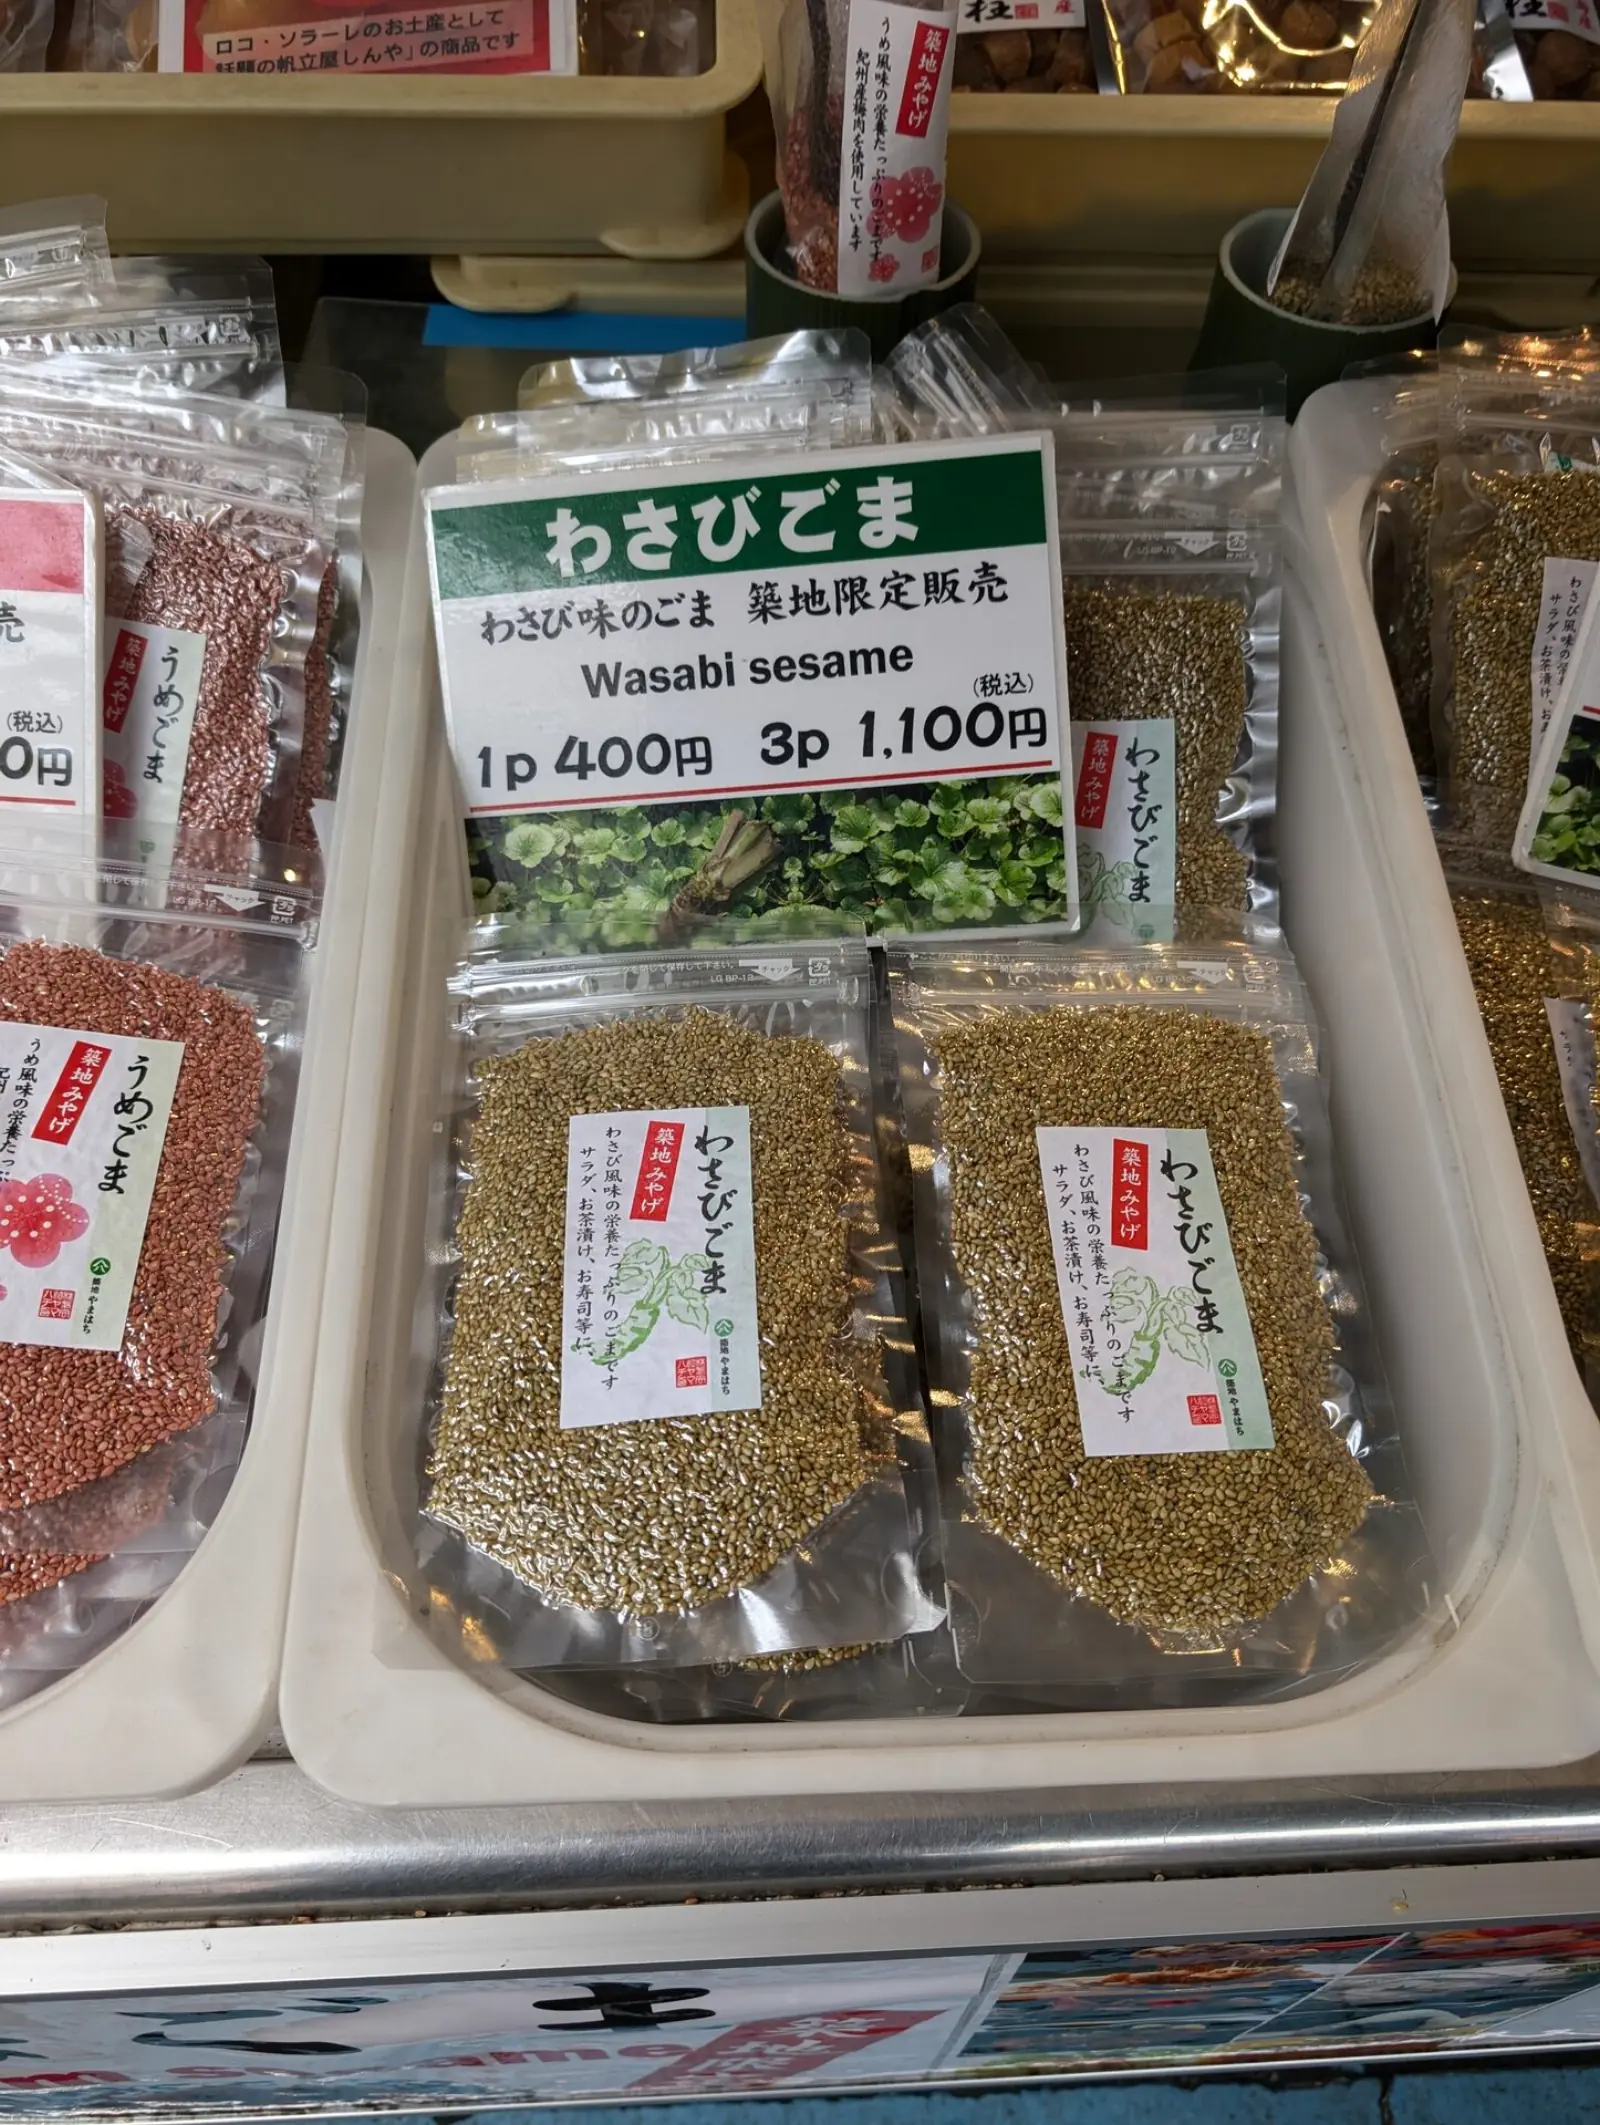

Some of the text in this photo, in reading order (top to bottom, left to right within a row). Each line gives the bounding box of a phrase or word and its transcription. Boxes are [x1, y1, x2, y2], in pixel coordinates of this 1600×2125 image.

[216, 9, 505, 55] ロコ・ソラーレのお土産として
[908, 28, 942, 131] 築地みやげ
[848, 48, 870, 252] 紀州産梅肉を使用しています
[545, 475, 919, 577] わさびごま
[480, 562, 1009, 645] わさび味のごま 築地限定販売
[6, 710, 63, 735] (税込)
[143, 646, 184, 784] うめごま
[580, 645, 914, 698] Wasabi sesame
[972, 672, 1034, 699] (税込)
[477, 702, 1048, 792] 1p 400円 3p 1,100円
[1081, 739, 1109, 821] 築地みやげ
[1125, 737, 1163, 903] わさびごま
[48, 1048, 104, 1134] 築地みやげ
[98, 1055, 153, 1194] うめごま
[641, 1128, 676, 1214] 築地みやげ
[695, 1125, 738, 1294] わさびごま
[1120, 1147, 1142, 1240] 築地みやげ
[575, 1147, 598, 1358] サラダ、お茶漬け、お寿司等に、
[601, 1127, 622, 1390] わさび風味の栄養たっぷりのごまです
[1052, 1163, 1104, 1385] サラダ、お茶漬け、お寿司等に、
[1074, 1144, 1135, 1423] わさび風味の栄養たっぷりのごまです
[1161, 1149, 1223, 1334] わさびごま
